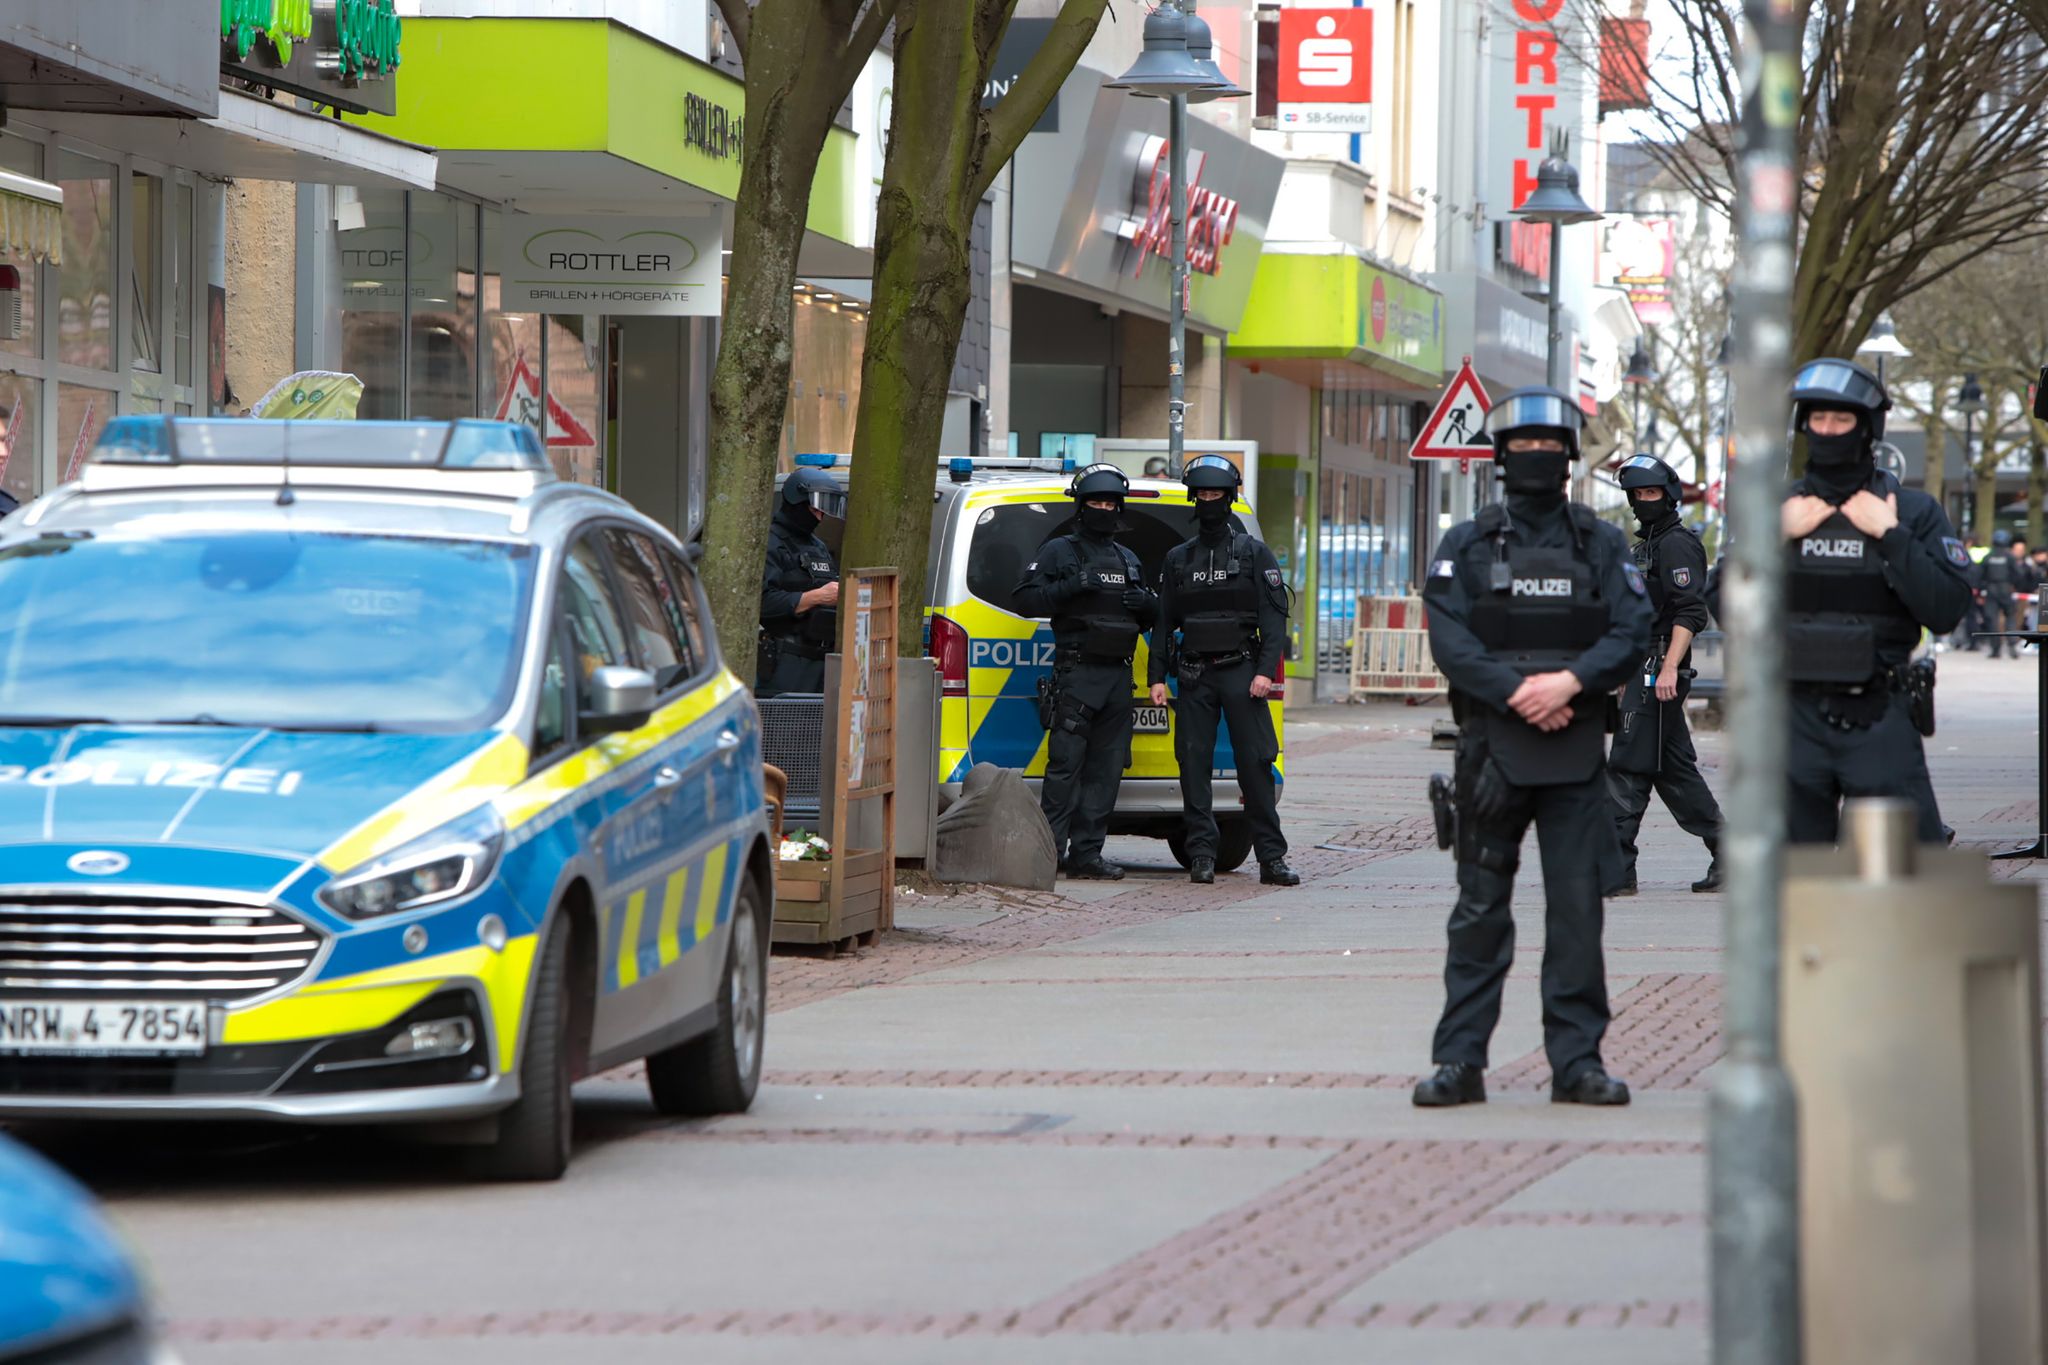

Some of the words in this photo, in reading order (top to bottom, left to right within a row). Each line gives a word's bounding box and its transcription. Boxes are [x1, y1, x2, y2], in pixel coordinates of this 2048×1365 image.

[1306, 112, 1367, 125] SB-Service
[550, 252, 671, 272] ROTTLER
[529, 289, 588, 300] BRILLEN
[601, 289, 689, 302] HÖRGERÄTE
[1801, 539, 1864, 558] POLIZEI
[1100, 573, 1125, 584] OLIZEI
[1193, 571, 1226, 582] POZEI
[1512, 579, 1572, 597] POLIZEI
[972, 641, 1056, 667] POLIZ
